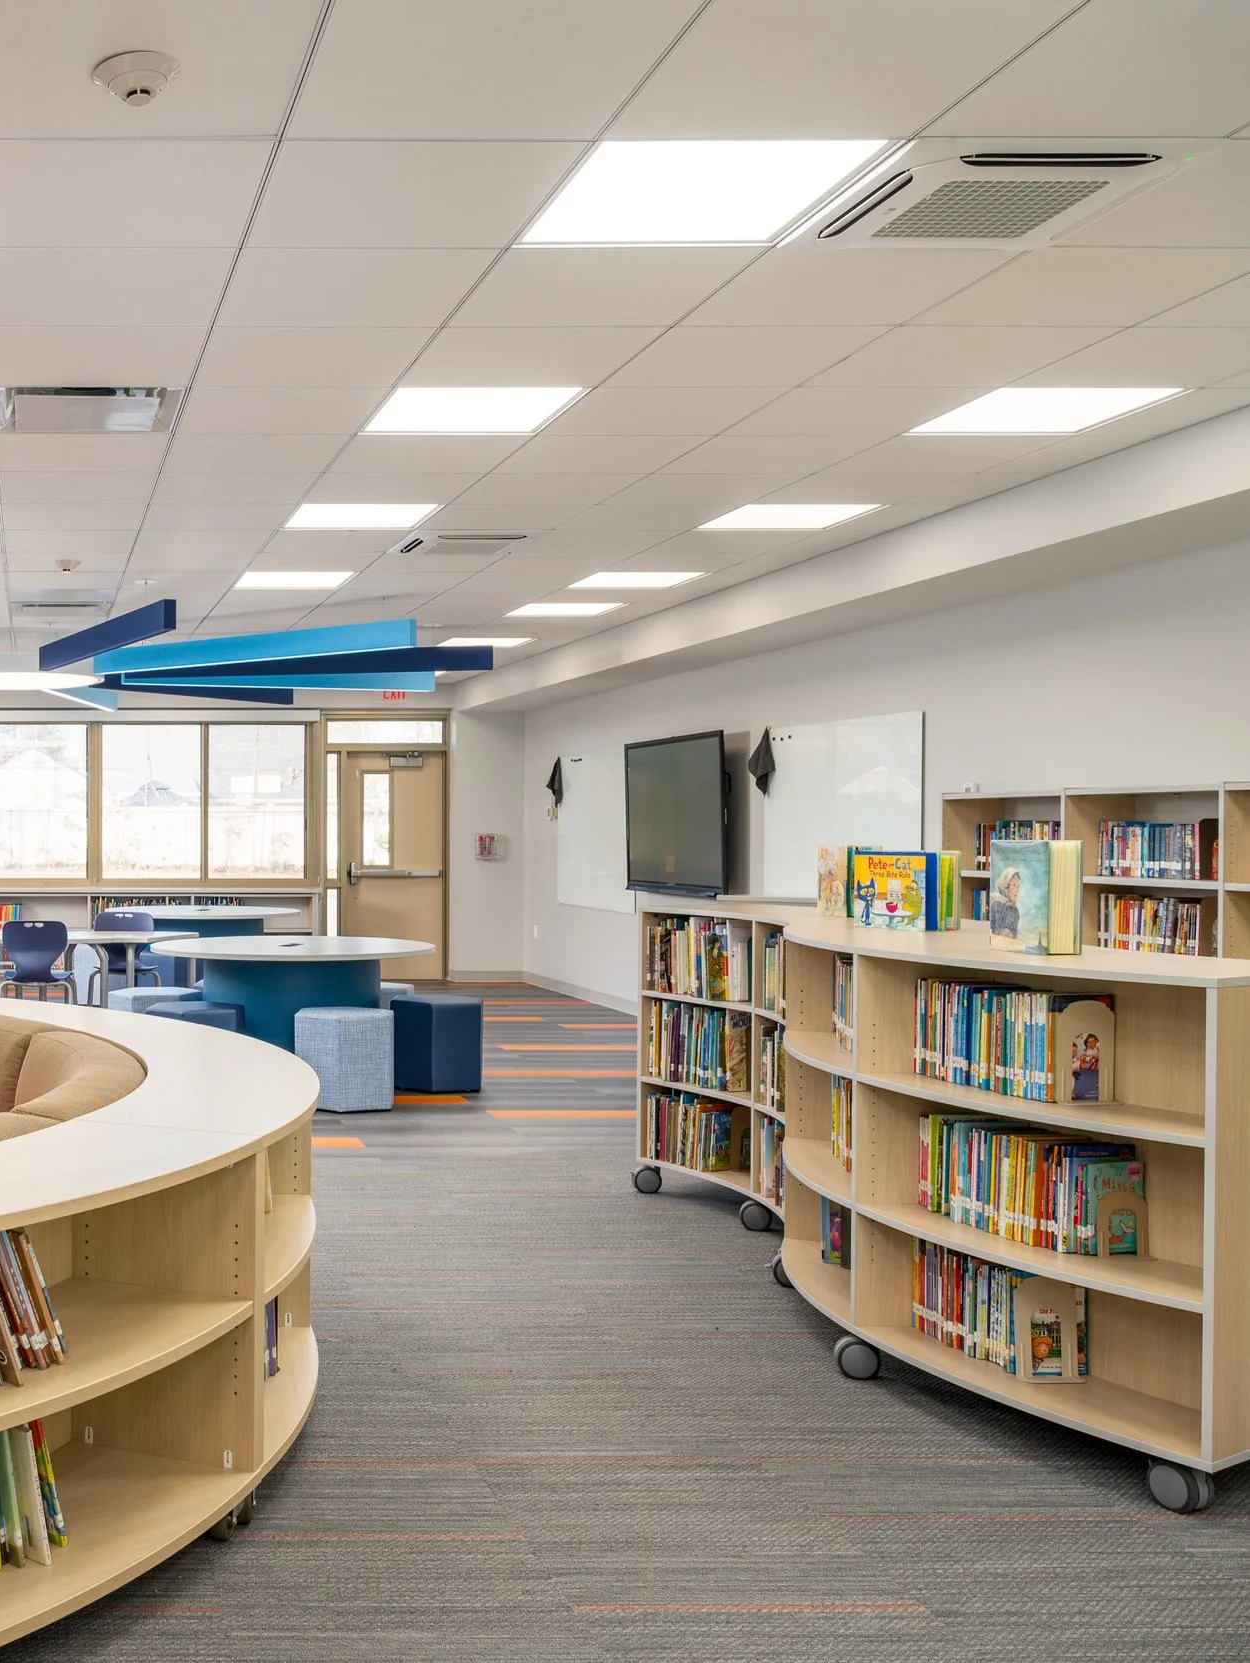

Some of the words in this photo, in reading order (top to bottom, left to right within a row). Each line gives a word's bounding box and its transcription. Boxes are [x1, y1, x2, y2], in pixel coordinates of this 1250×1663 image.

[868, 856, 888, 870] Pete
[895, 858, 912, 871] Cat
[869, 870, 886, 879] Three
[886, 870, 898, 879] Bite
[899, 871, 912, 879] Rule
